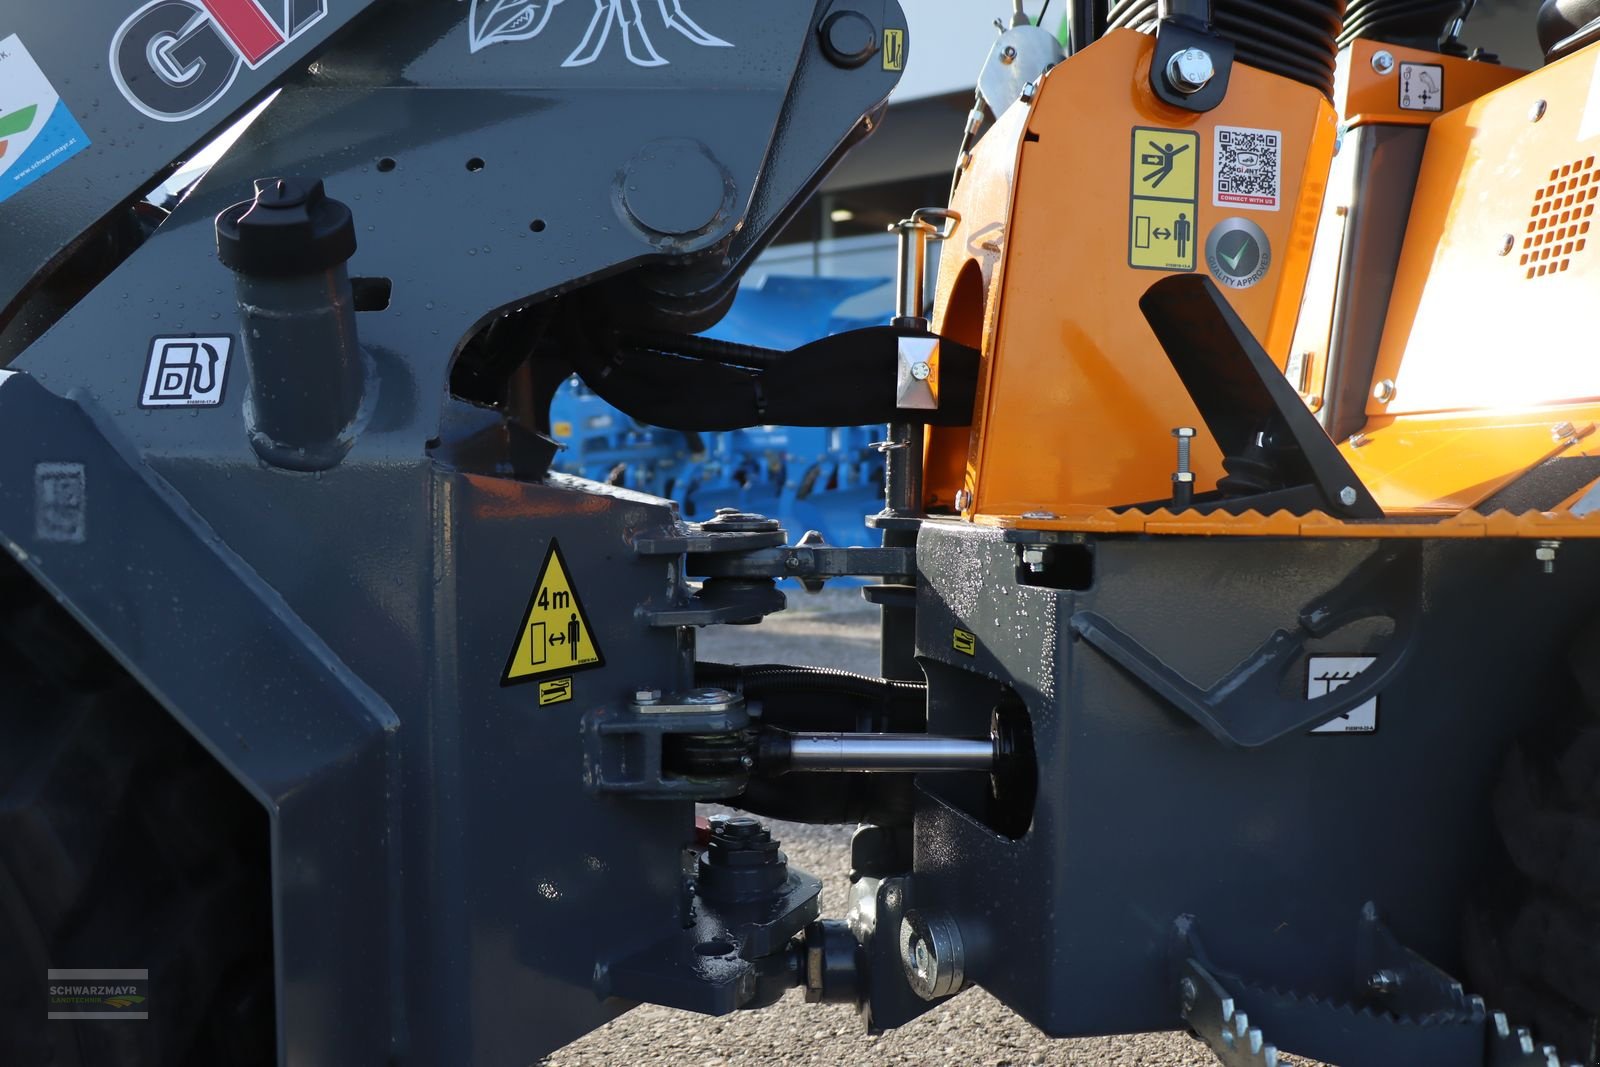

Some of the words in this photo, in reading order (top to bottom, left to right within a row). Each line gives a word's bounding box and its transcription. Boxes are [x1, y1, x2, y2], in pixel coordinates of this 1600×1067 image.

[13, 137, 77, 181] www.schwarzmayr.at
[1220, 194, 1248, 203] CONNECT
[1208, 256, 1235, 286] QUALITY
[1237, 252, 1270, 287] APPROVED
[164, 373, 183, 390] D
